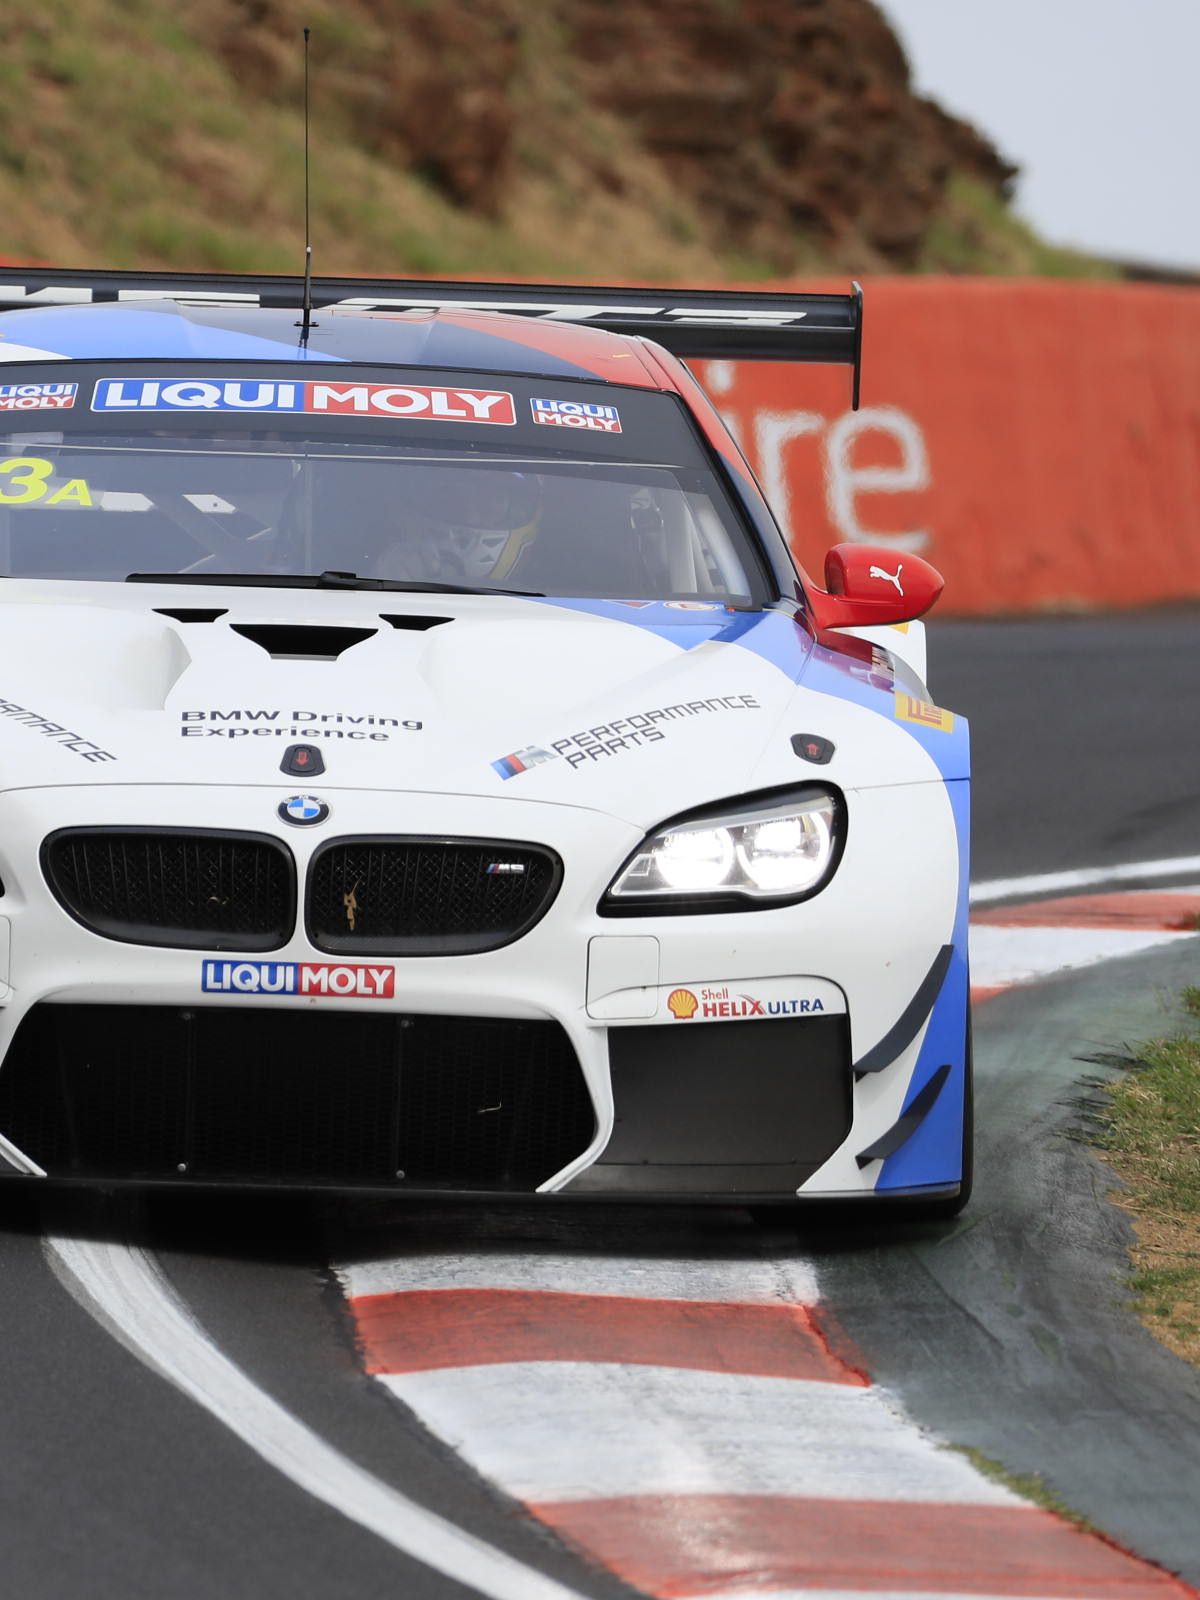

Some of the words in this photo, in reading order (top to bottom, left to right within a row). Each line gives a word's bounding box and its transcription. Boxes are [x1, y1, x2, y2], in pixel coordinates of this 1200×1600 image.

[105, 381, 295, 409] LIQUI
[313, 385, 505, 419] MOLY
[535, 399, 614, 419] LIQUI
[537, 411, 618, 431] MOLY
[181, 710, 281, 722] BMW
[292, 711, 423, 731] Driving
[550, 695, 761, 756] PERFORMANCE
[181, 726, 390, 742] Experience
[565, 726, 666, 769] PARTS
[206, 963, 295, 993] LIQUI
[301, 967, 392, 995] MOLY
[701, 988, 728, 1001] Shell
[703, 998, 765, 1017] HELIX
[767, 998, 824, 1014] ULTRA
